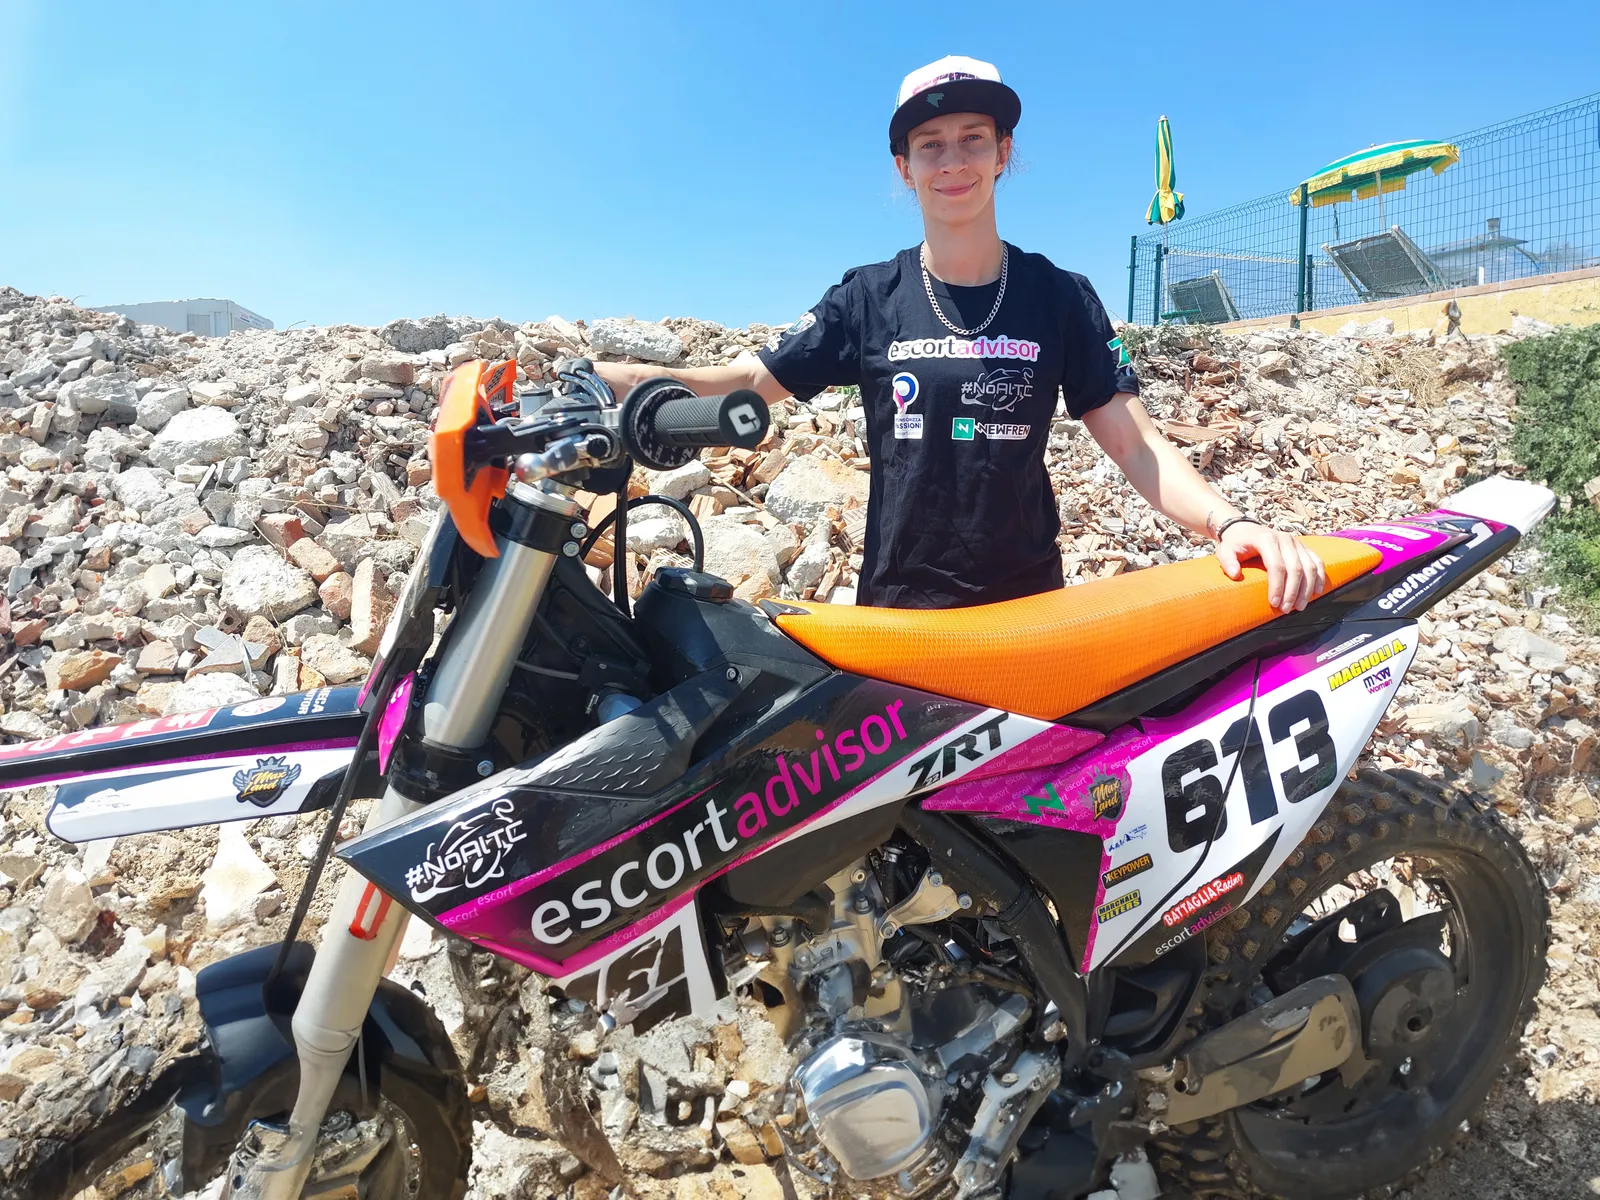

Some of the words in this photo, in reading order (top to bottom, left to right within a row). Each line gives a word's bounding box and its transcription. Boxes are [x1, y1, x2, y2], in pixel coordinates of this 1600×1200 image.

[890, 337, 1039, 359] escortadvisor
[977, 422, 1030, 436] NEWFREN
[1327, 643, 1393, 692] MAGNOLI
[1391, 638, 1408, 656] A.
[1161, 689, 1338, 853] 613
[530, 699, 908, 945] escortadvisor
[1108, 855, 1151, 880] KEYPOWER
[477, 885, 515, 906] escort
[1162, 886, 1217, 927] BATTAGLIA
[1212, 873, 1244, 895] Racing
[442, 907, 480, 926] escort
[1100, 900, 1141, 923] FILTERS
[1155, 901, 1234, 956] escortadvisor
